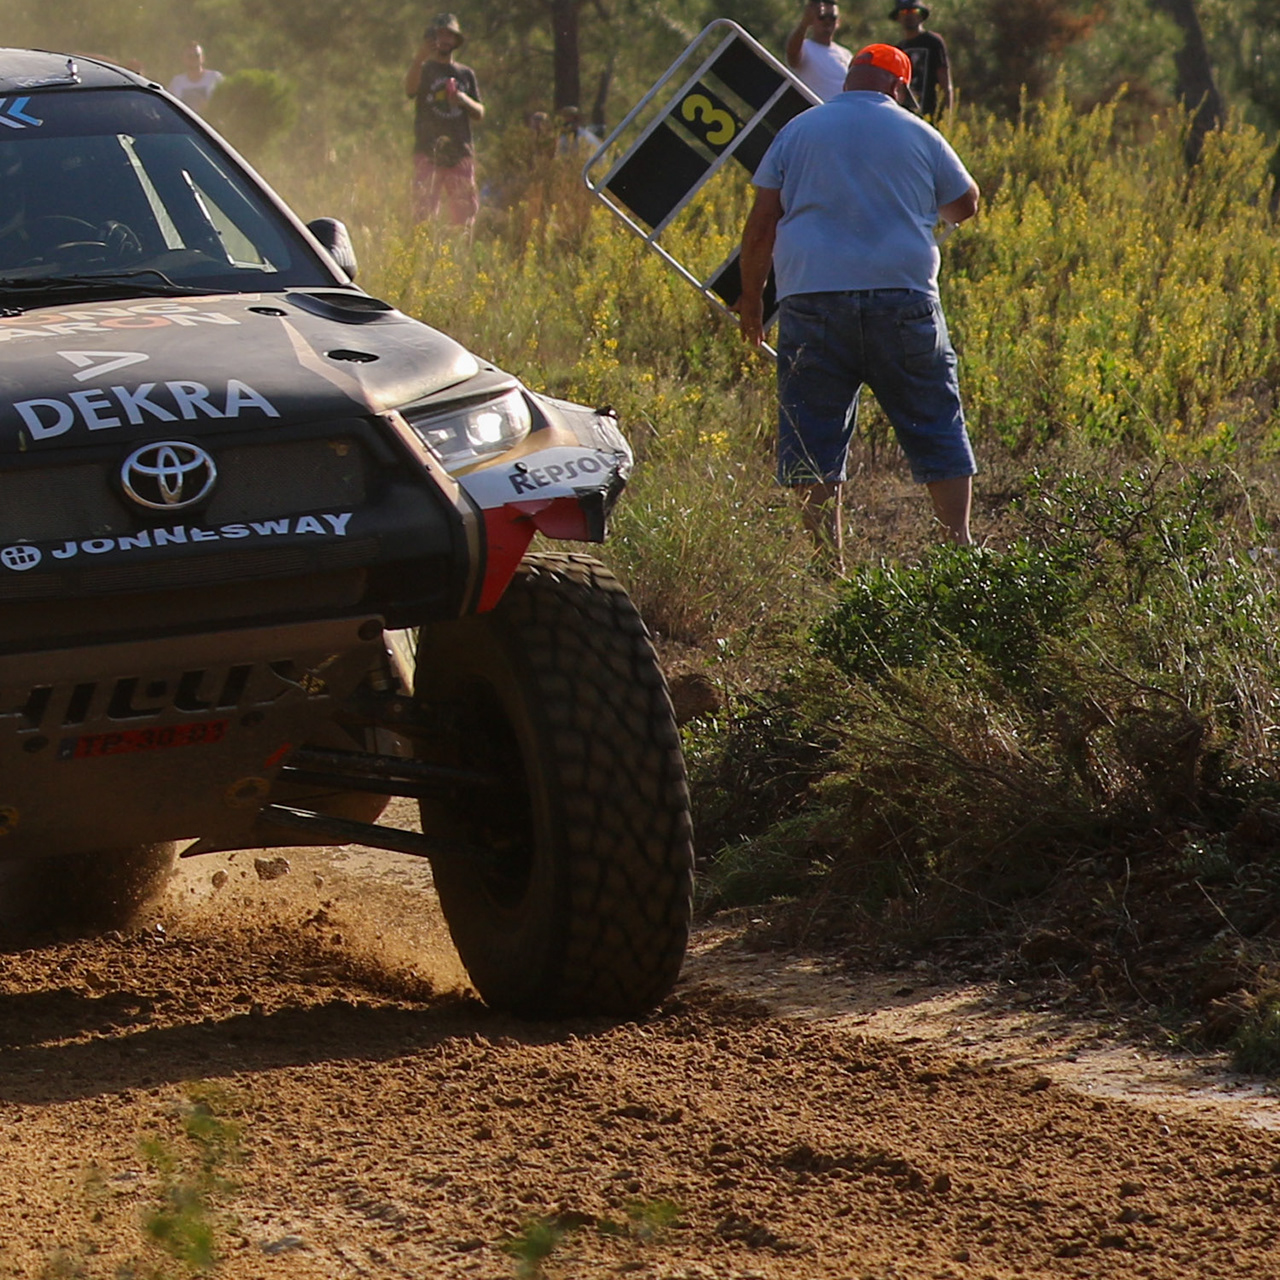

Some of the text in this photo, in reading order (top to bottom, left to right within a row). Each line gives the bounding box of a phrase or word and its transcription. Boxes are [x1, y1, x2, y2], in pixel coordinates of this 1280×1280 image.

[682, 94, 735, 145] 3
[13, 379, 280, 440] DEKRA
[509, 454, 616, 495] REPSOL
[52, 513, 352, 559] JONNESWAY
